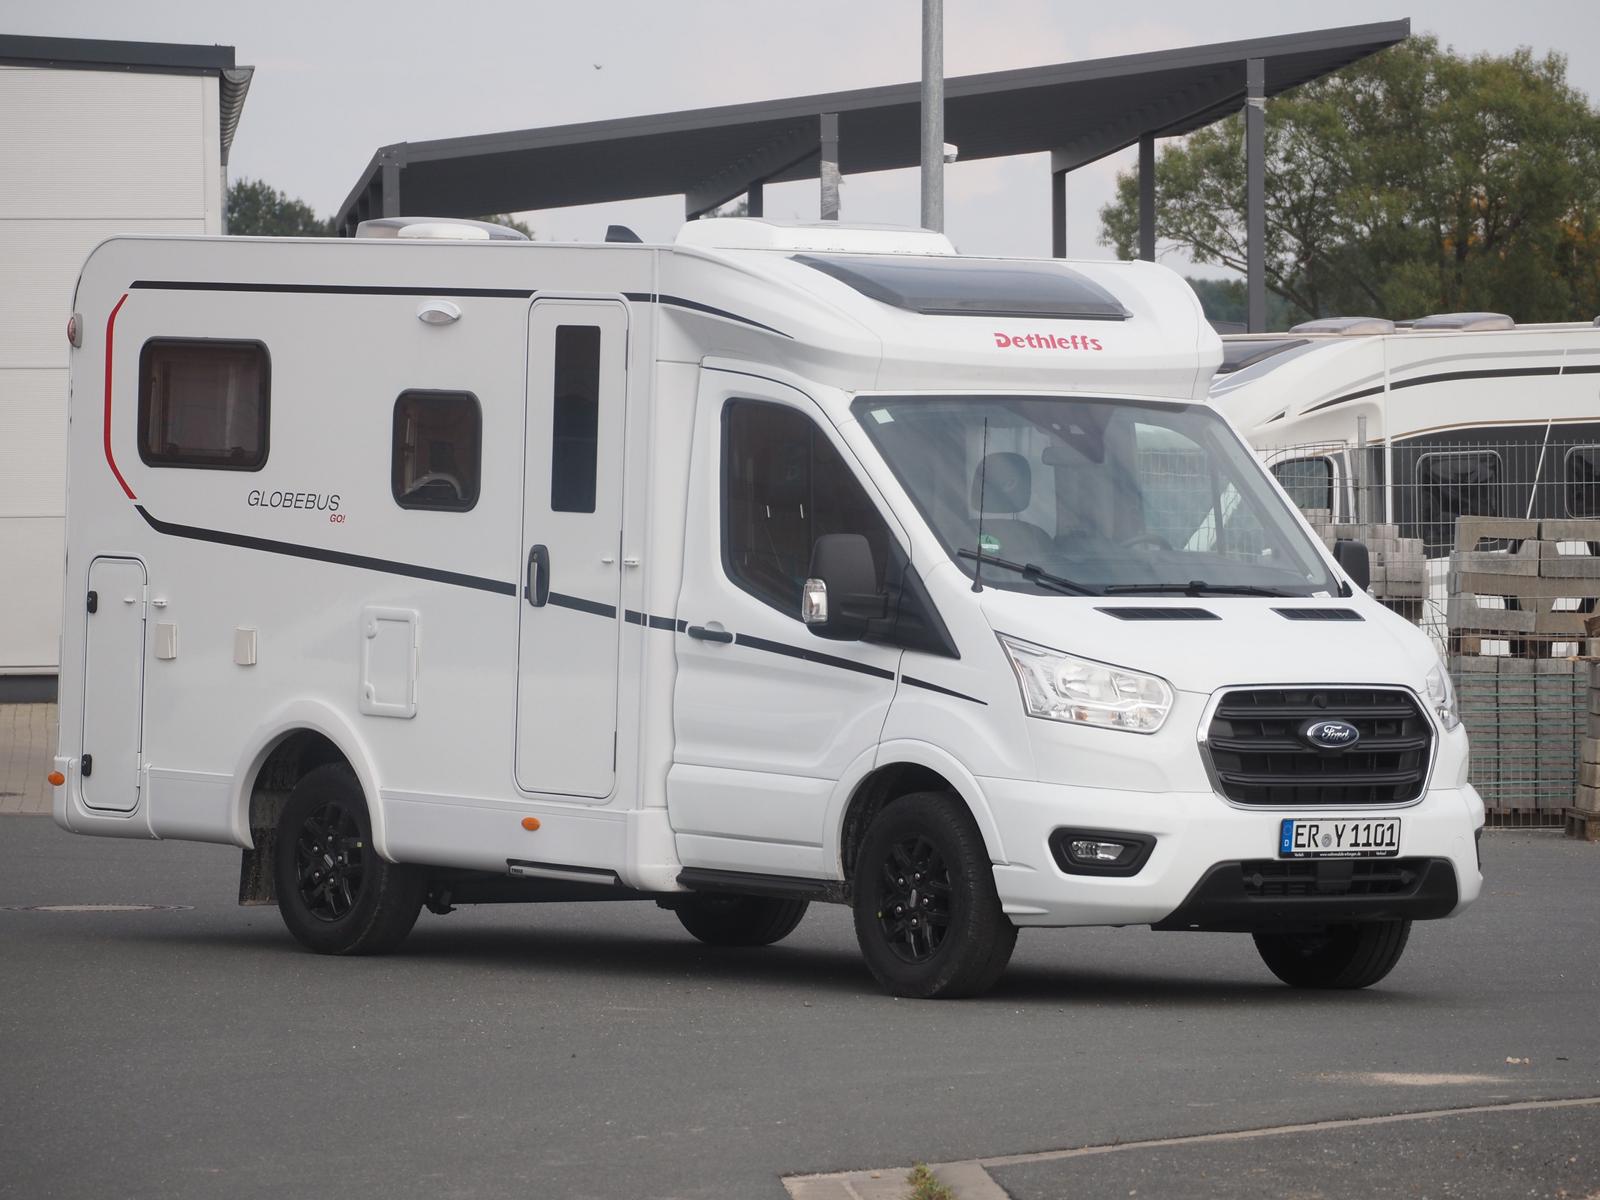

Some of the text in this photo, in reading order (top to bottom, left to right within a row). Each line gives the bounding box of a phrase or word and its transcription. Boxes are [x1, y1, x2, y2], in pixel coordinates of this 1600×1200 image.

[993, 332, 1103, 351] Dethleffs
[247, 490, 341, 511] GLOBEBUS
[329, 513, 346, 523] GO!
[1321, 725, 1350, 741] Ford
[1284, 839, 1290, 847] D
[1294, 823, 1395, 848] ER Y 1101
